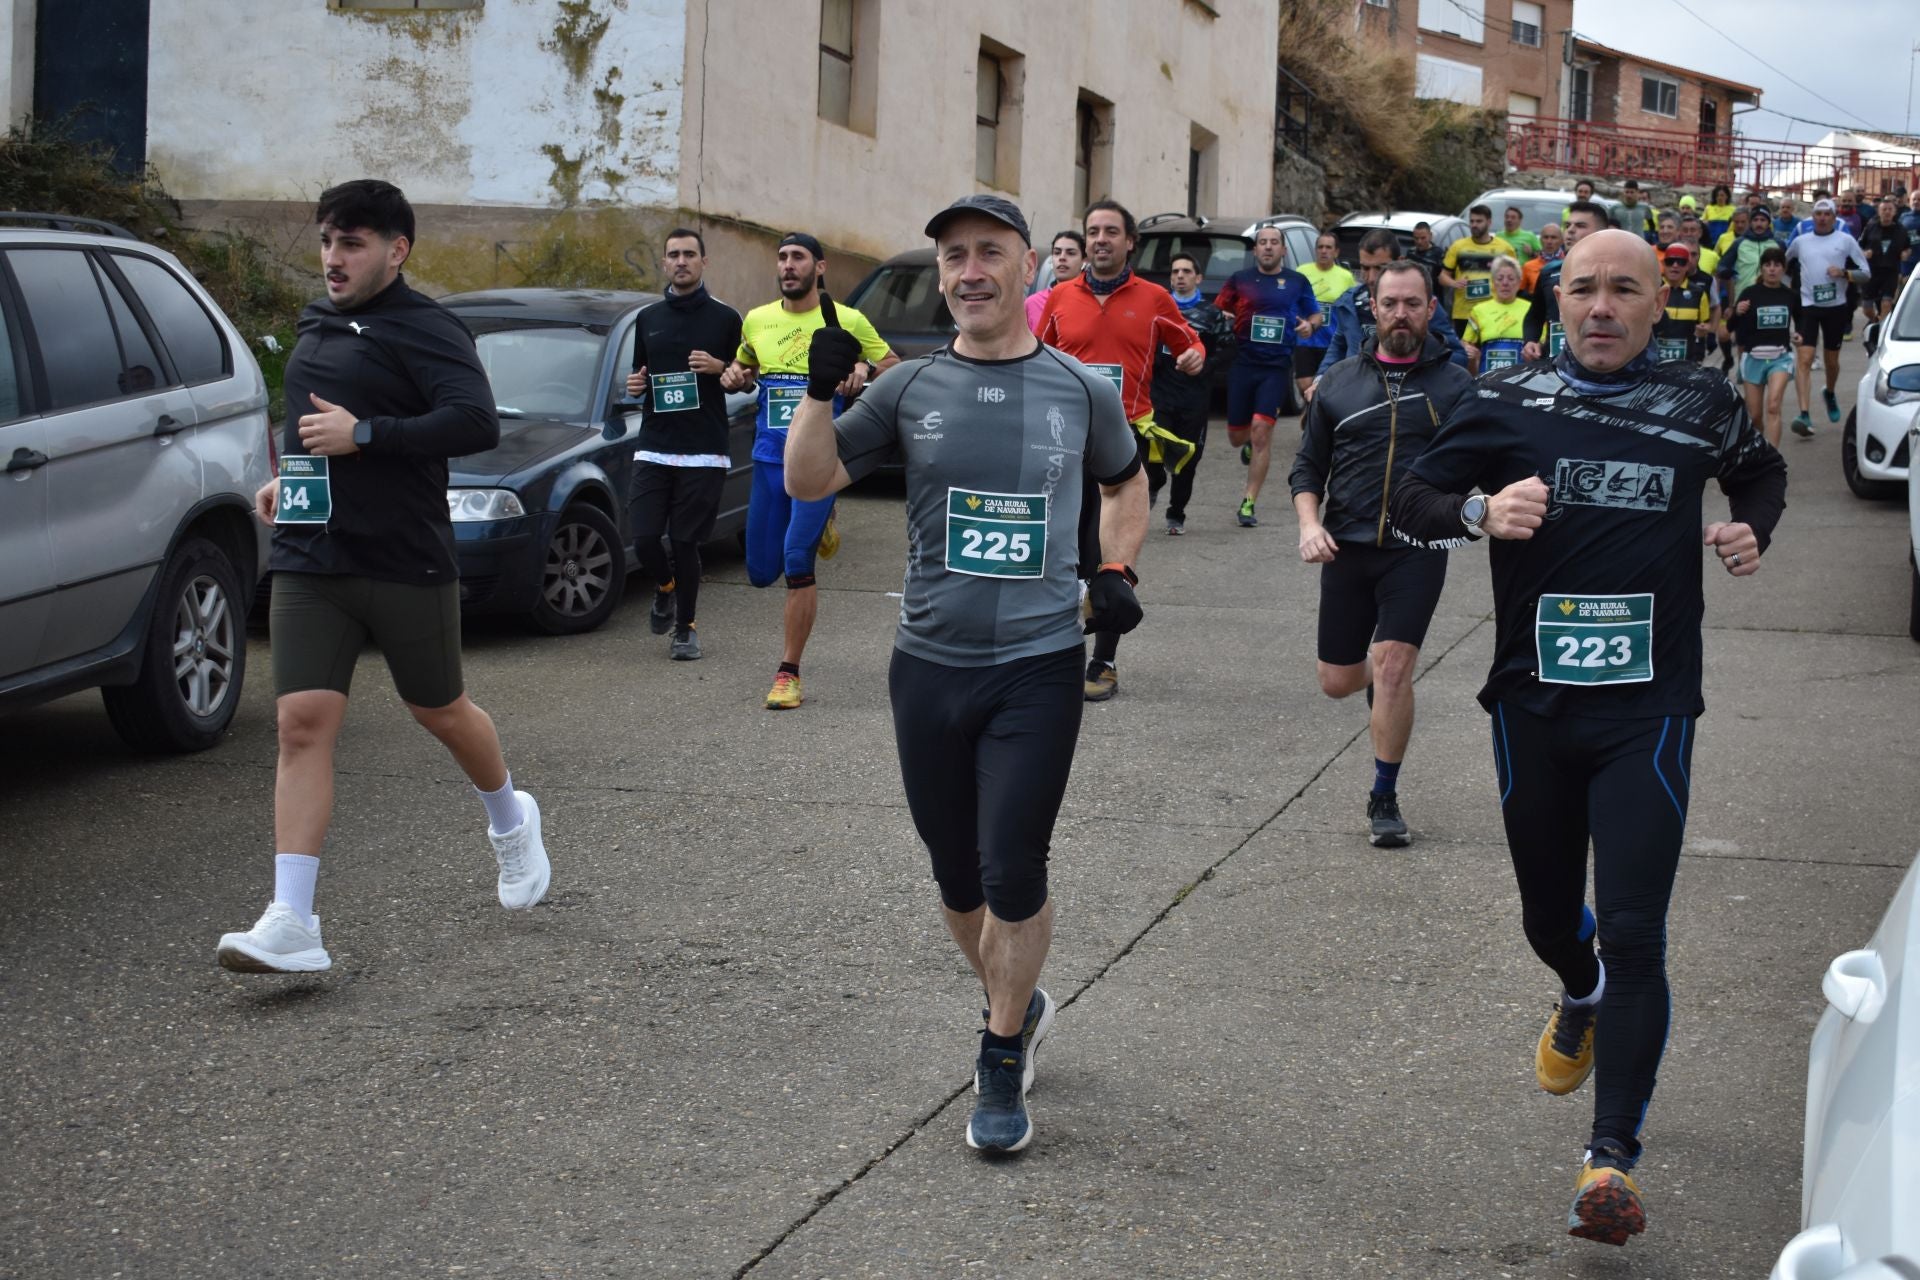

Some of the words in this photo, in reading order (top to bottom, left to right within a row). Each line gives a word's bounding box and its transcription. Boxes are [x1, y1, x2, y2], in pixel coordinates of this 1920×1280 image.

[1472, 287, 1483, 295] 41
[1260, 327, 1276, 338] 35
[1659, 349, 1680, 359] 211
[664, 389, 685, 405] 68
[780, 405, 798, 420] 2
[283, 486, 311, 510] 34
[984, 499, 1004, 508] CAJA
[1004, 500, 1029, 508] RURAL
[984, 505, 995, 513] DE
[996, 506, 1031, 515] NAVARRA
[961, 529, 1031, 562] 225
[1579, 602, 1599, 610] CAJA
[1600, 601, 1628, 609] RURAL
[1579, 609, 1591, 617] DE
[1592, 608, 1631, 617] NAVARRA
[1555, 635, 1632, 668] 223
